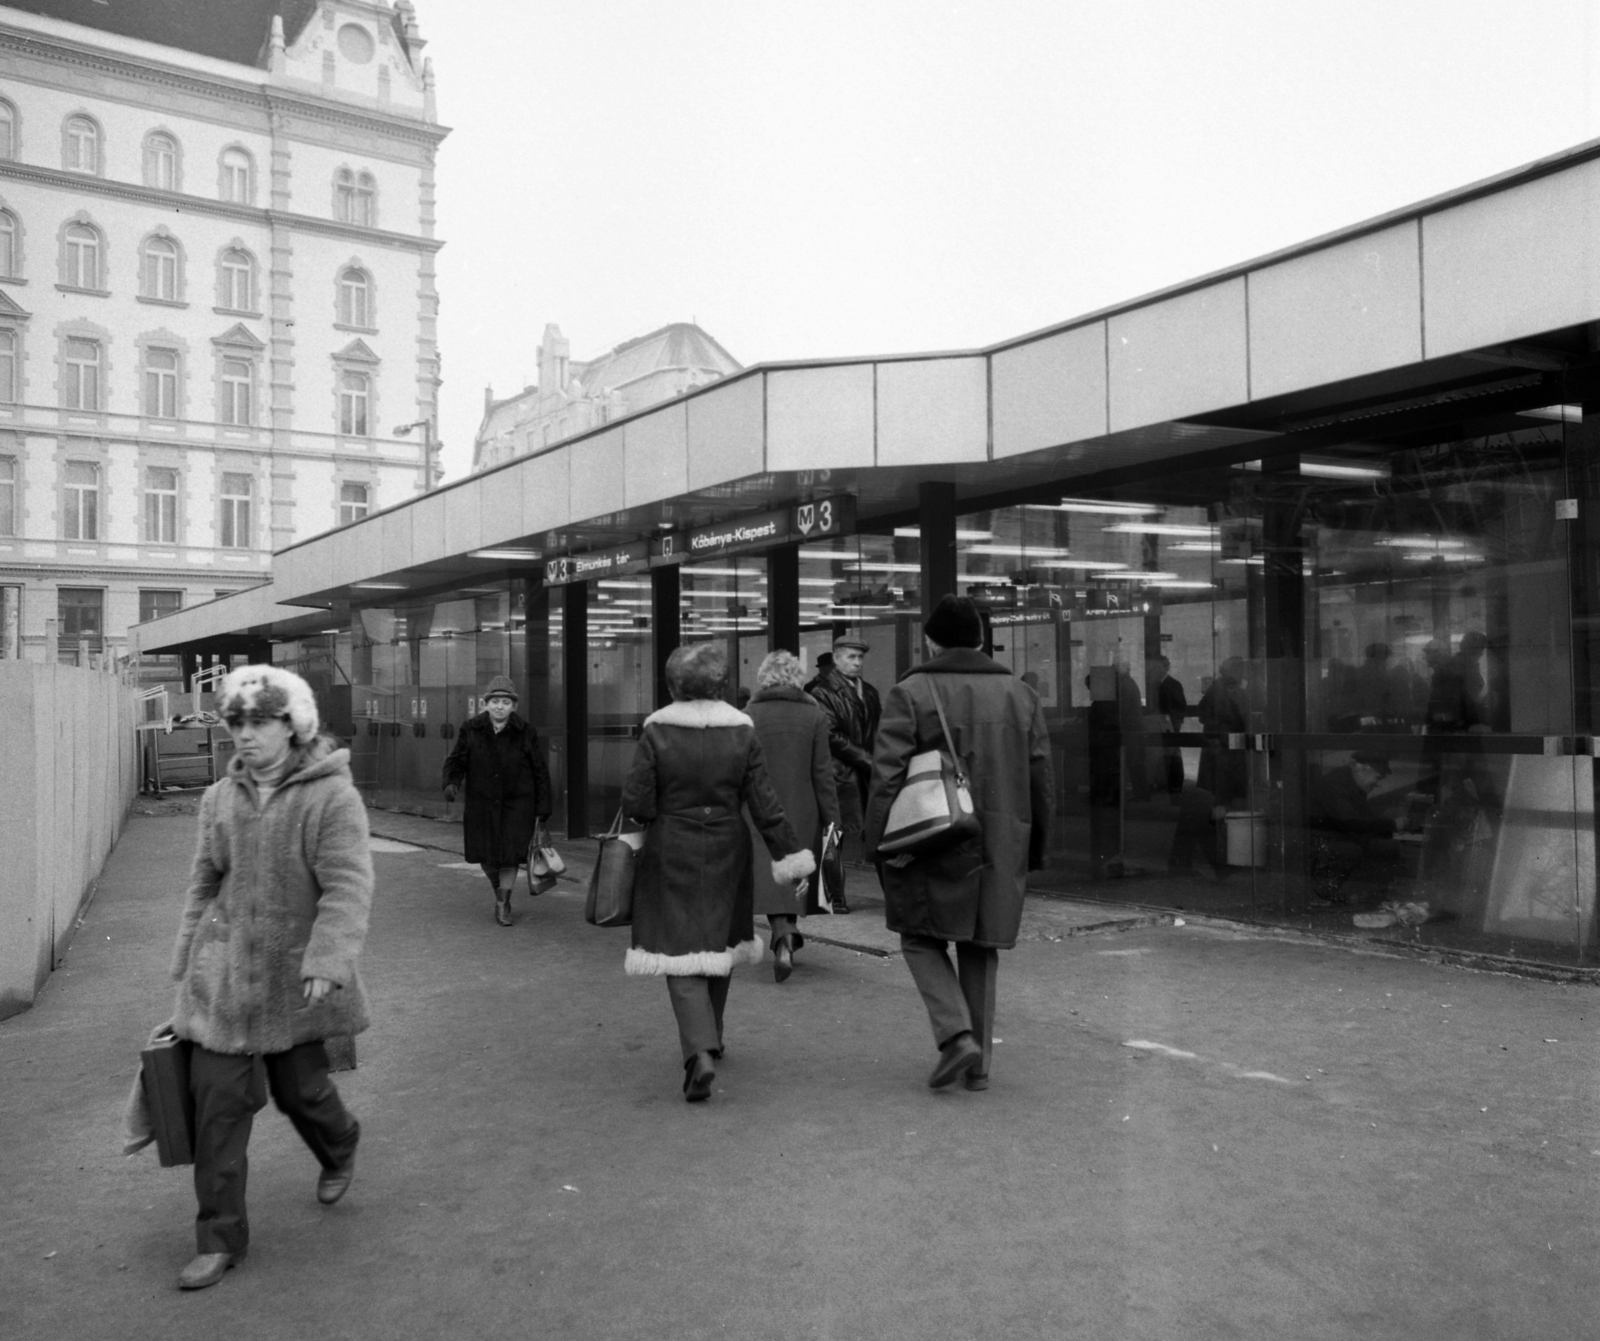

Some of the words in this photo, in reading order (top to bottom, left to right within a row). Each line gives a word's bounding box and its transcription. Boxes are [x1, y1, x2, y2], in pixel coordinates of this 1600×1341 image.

[691, 521, 776, 549] Kőbánya-Kispest
[819, 500, 832, 532] 3
[560, 559, 567, 581] 3
[616, 550, 630, 565] tér
